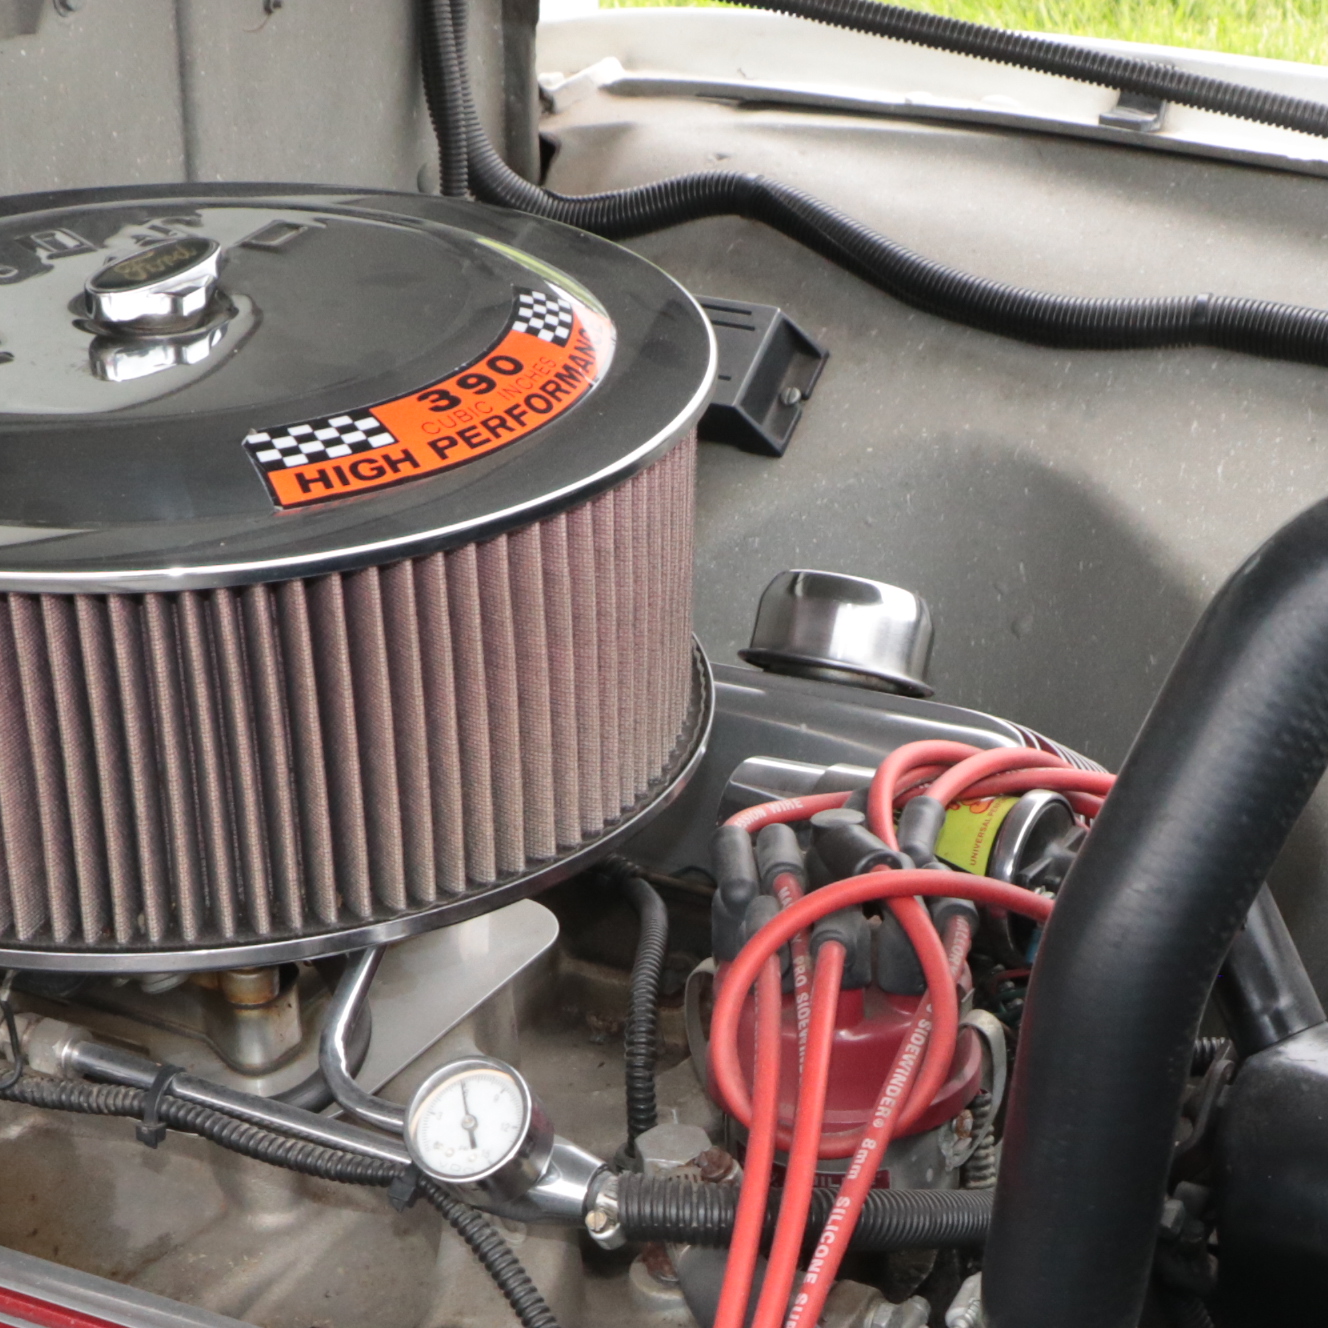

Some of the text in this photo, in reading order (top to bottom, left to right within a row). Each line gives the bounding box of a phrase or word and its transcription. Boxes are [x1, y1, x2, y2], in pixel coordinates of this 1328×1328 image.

[113, 241, 197, 281] Ford
[294, 320, 604, 493] HIGH PERFORMANCE
[417, 354, 524, 413] 390
[422, 356, 557, 435] CUBIC INCHES
[765, 799, 804, 814] WIRE
[970, 818, 993, 866] UNIVERSAL
[793, 955, 808, 988] PRO
[847, 1138, 877, 1180] 8mm
[803, 1196, 851, 1284] SILICONE
